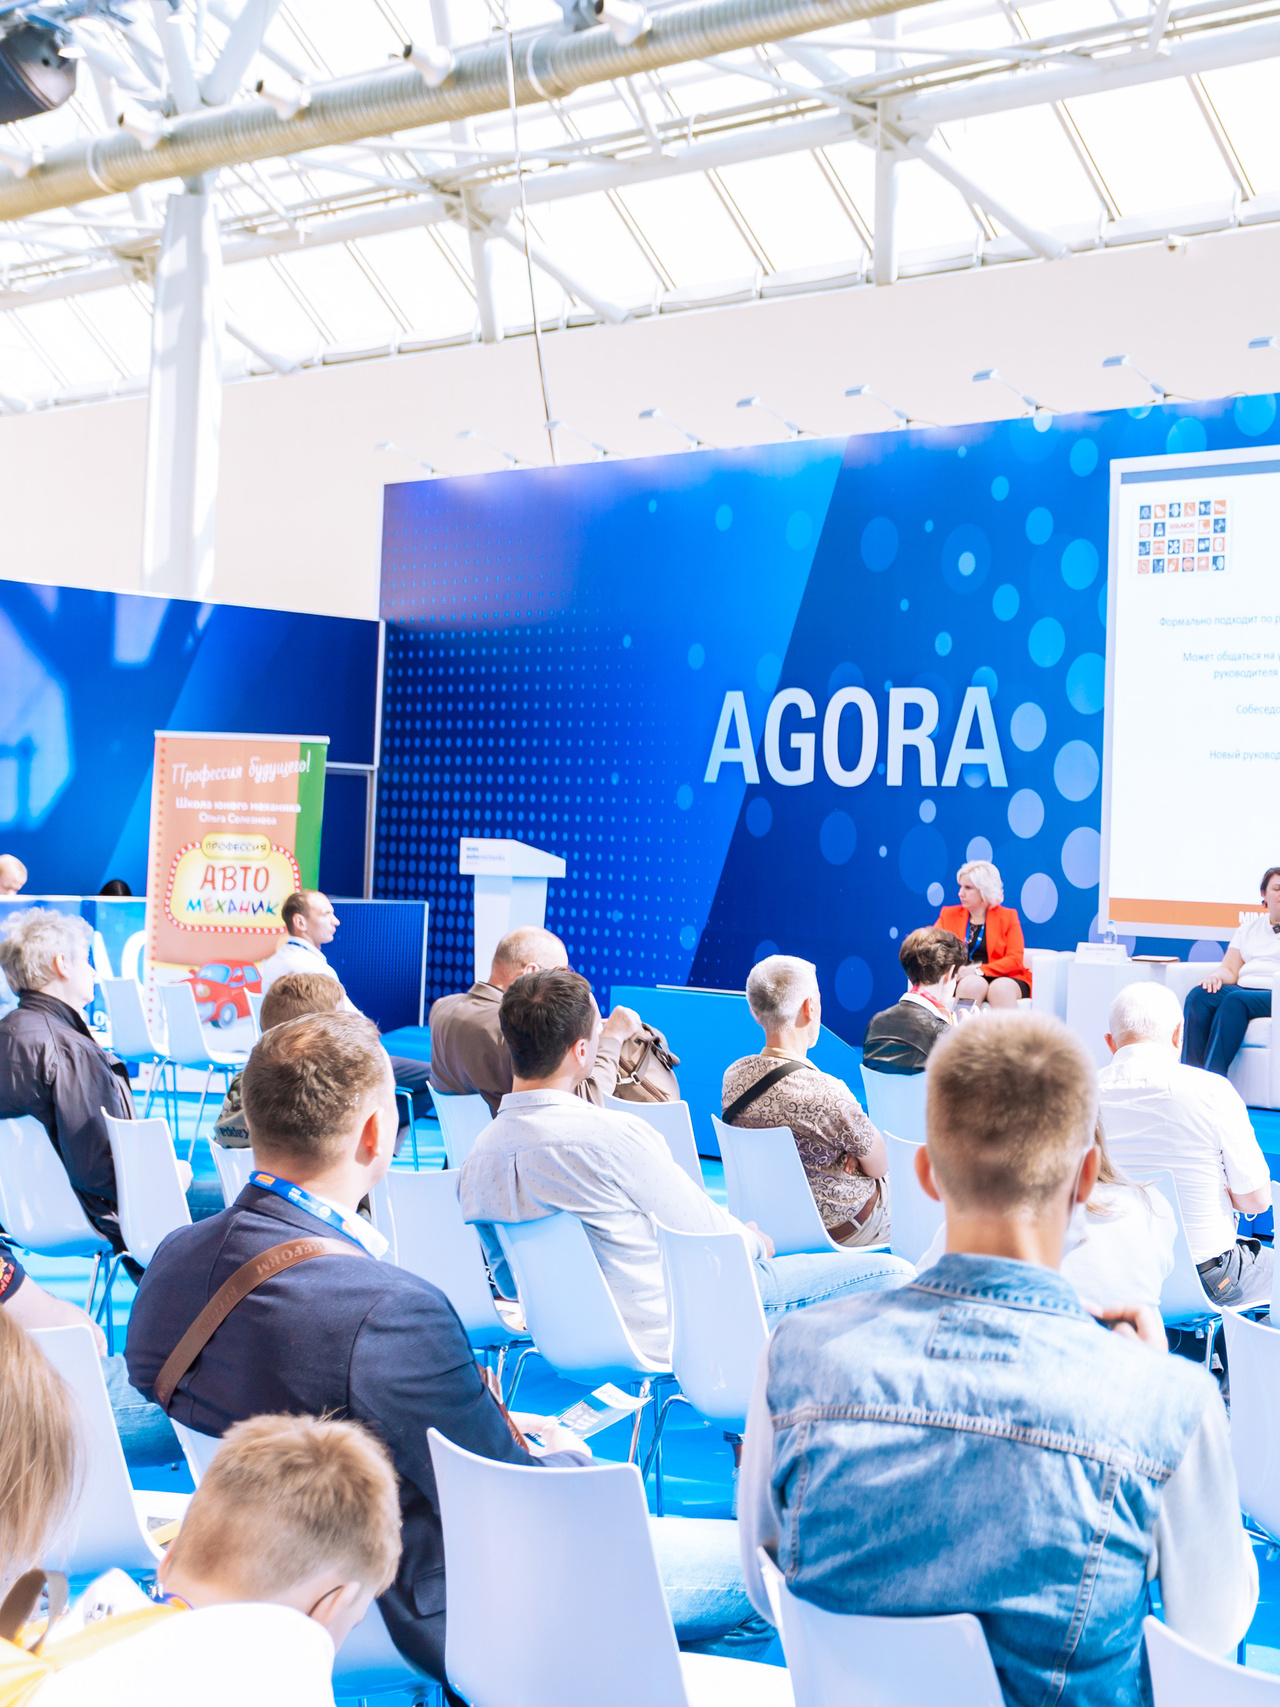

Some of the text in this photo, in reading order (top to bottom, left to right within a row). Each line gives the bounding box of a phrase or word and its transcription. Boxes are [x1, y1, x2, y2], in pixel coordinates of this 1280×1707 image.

[1159, 617, 1212, 628] Формально
[1215, 615, 1258, 625] подходит
[1260, 615, 1272, 623] по
[1183, 652, 1214, 662] Может
[1216, 650, 1261, 662] общаться
[1264, 652, 1275, 660] на
[1213, 669, 1278, 680] руководителя
[703, 686, 1009, 788] AGORA
[1209, 749, 1240, 760] Новый
[172, 748, 311, 790] Профессия будущего!
[175, 797, 302, 813] Школа юного механика
[199, 812, 277, 825] Ольга Селезнева
[205, 842, 267, 852] ПРОФЕССИЯ
[200, 864, 270, 893] АВТО
[185, 898, 280, 916] МЕХАНИК
